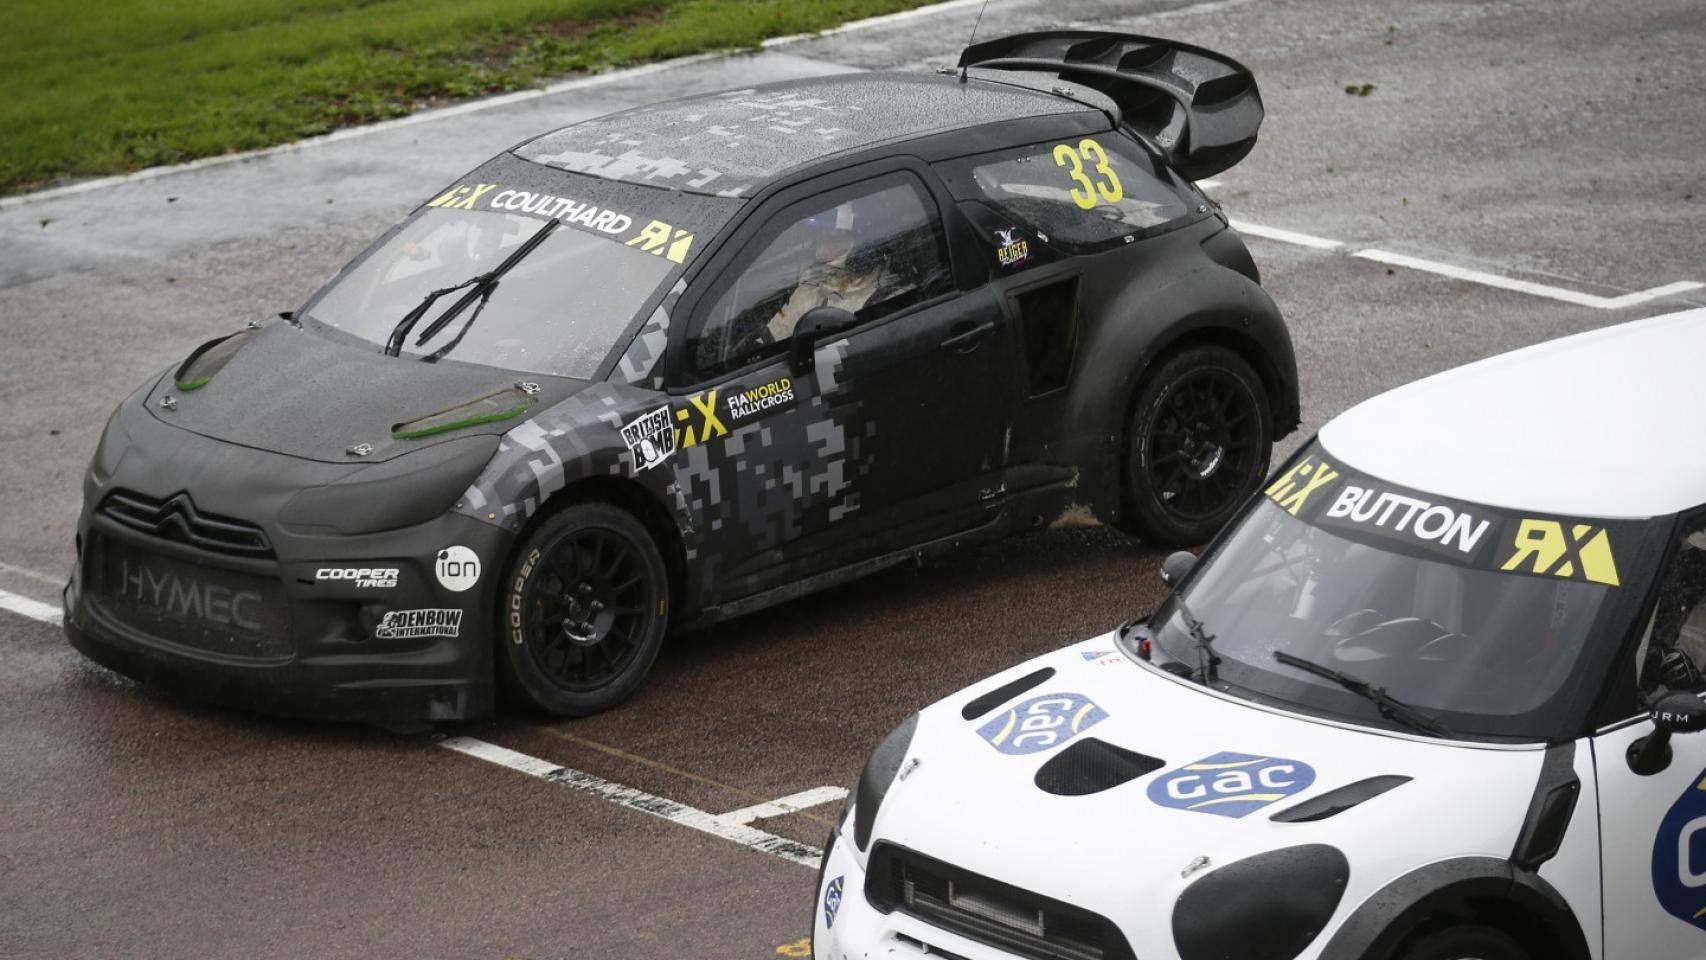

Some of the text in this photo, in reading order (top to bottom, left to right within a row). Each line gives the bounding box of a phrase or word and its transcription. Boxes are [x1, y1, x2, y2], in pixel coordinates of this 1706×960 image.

[1052, 139, 1123, 209] 33
[491, 191, 632, 234] COULTHARD
[731, 389, 794, 420] RALLYCROSS
[622, 408, 671, 445] BRITISH
[632, 427, 675, 467] BOMB
[1327, 486, 1490, 553] BUTTON
[316, 568, 400, 580] COOPER
[441, 551, 477, 578] ion
[121, 559, 263, 630] HYMEC
[355, 579, 398, 588] TIRES
[510, 548, 541, 645] COOPER
[396, 626, 457, 637] INTERNATIONAL
[398, 611, 461, 628] DENBOW
[1652, 711, 1688, 723] JRM
